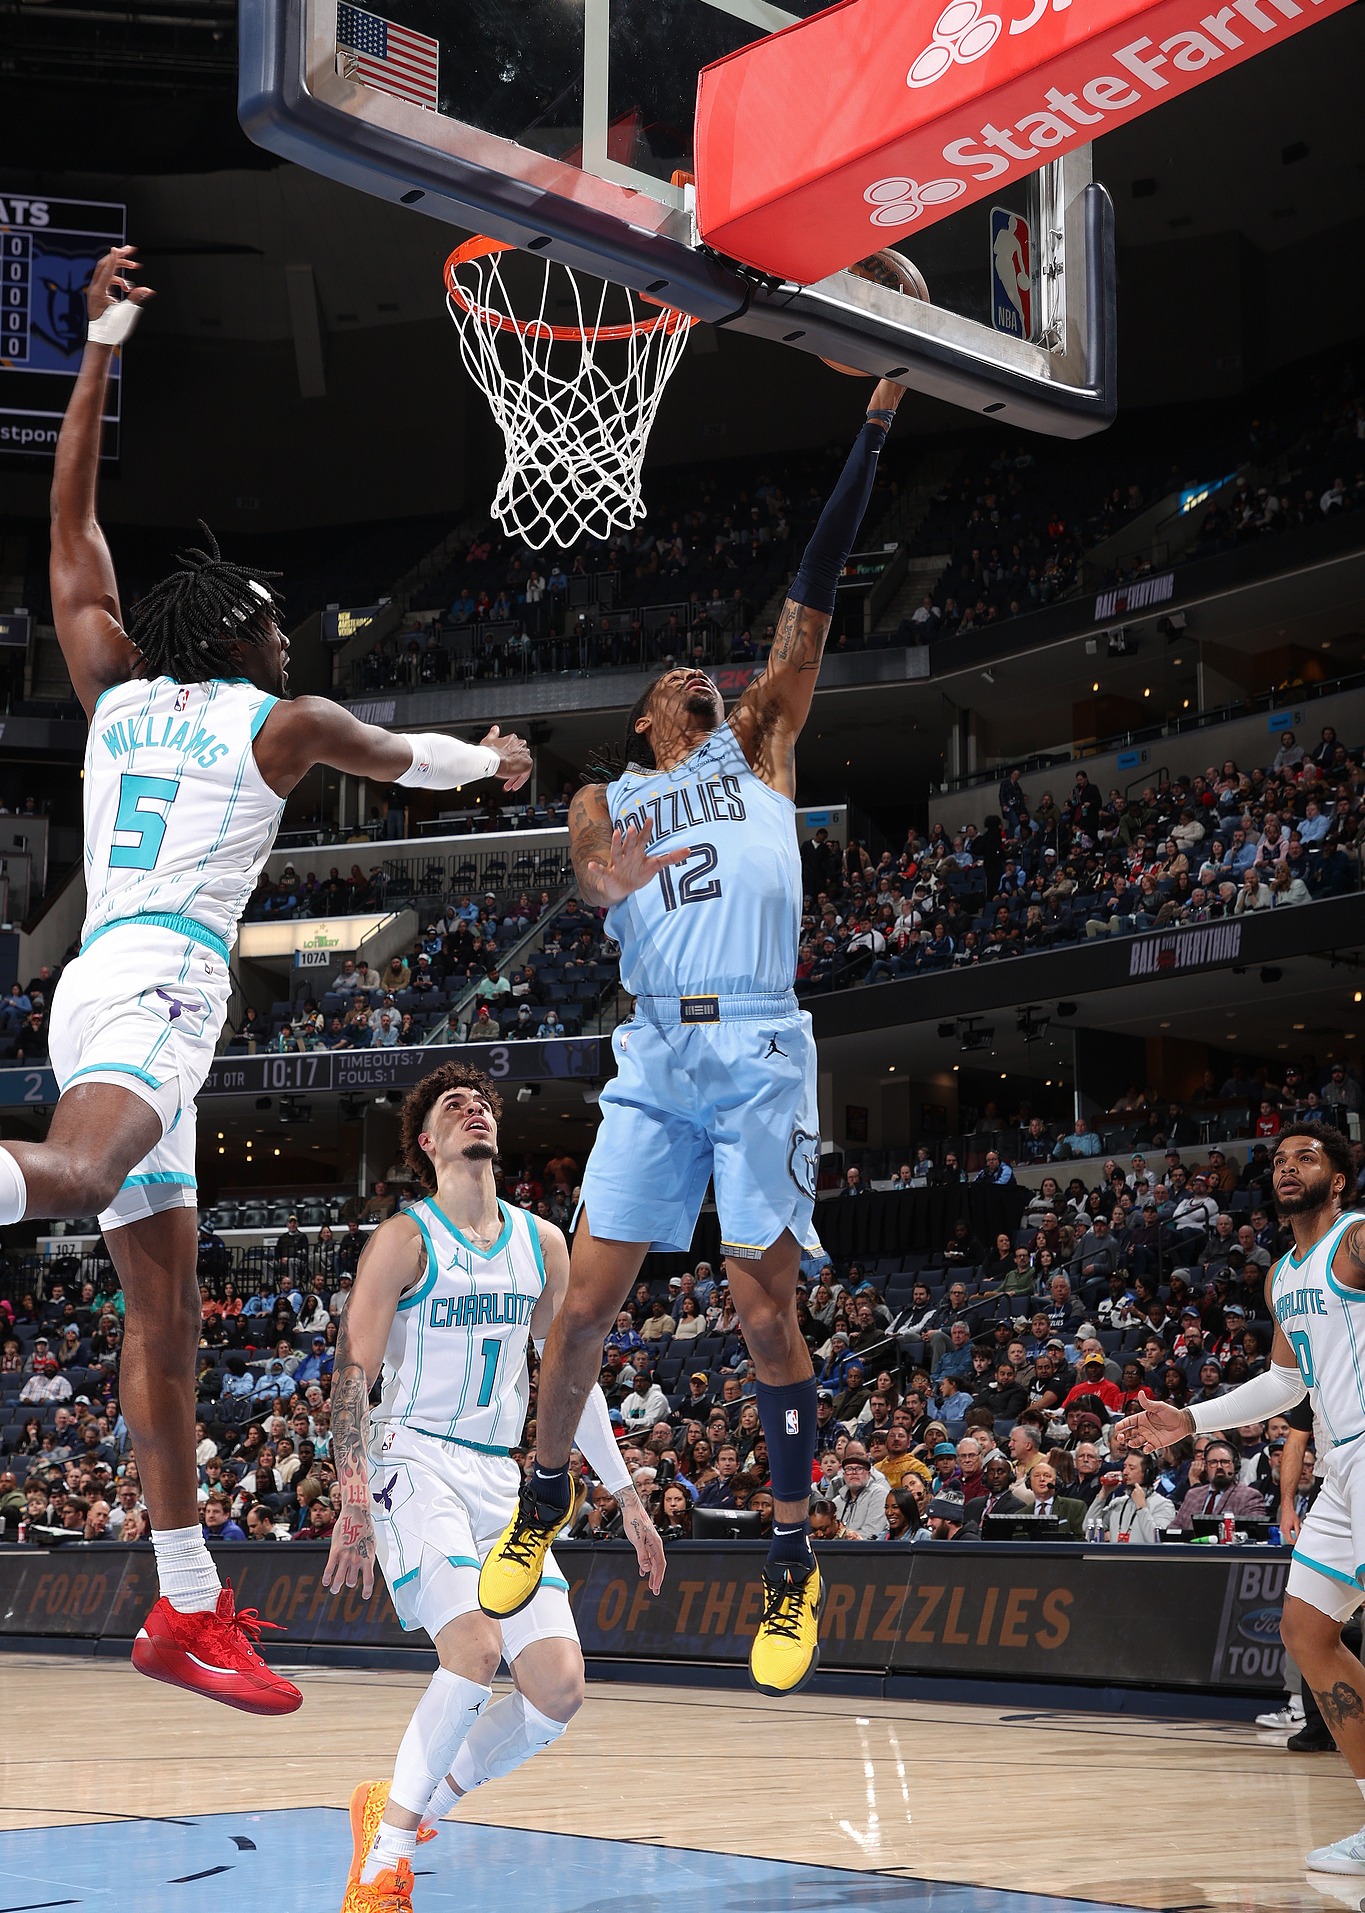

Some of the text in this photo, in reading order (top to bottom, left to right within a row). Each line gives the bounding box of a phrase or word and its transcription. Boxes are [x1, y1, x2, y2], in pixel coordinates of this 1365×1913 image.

[11, 237, 22, 256] 0
[10, 262, 22, 281] 0
[9, 287, 21, 306] 0
[9, 312, 20, 331] 0
[998, 306, 1018, 332] NBA
[8, 337, 20, 356] 0
[101, 716, 229, 768] WILLIAMS
[108, 773, 181, 870] 5
[657, 843, 722, 912] 12
[301, 952, 327, 964] 107A
[1129, 939, 1160, 977] BALL
[1174, 922, 1242, 969] EVERYTHING
[262, 1057, 319, 1089] 10:17
[338, 1053, 414, 1069] TIMEOUTS:
[488, 1047, 510, 1078] 3
[24, 1072, 44, 1102] 2
[223, 1072, 245, 1088] QTR
[338, 1070, 387, 1085] FOULS:
[56, 1244, 75, 1255] 107
[1289, 1329, 1315, 1389] 0
[476, 1338, 502, 1408] 1
[28, 1574, 107, 1617] FORD
[596, 1578, 651, 1633] OF
[674, 1581, 764, 1636] THE
[818, 1583, 1075, 1650] RIZZLIES
